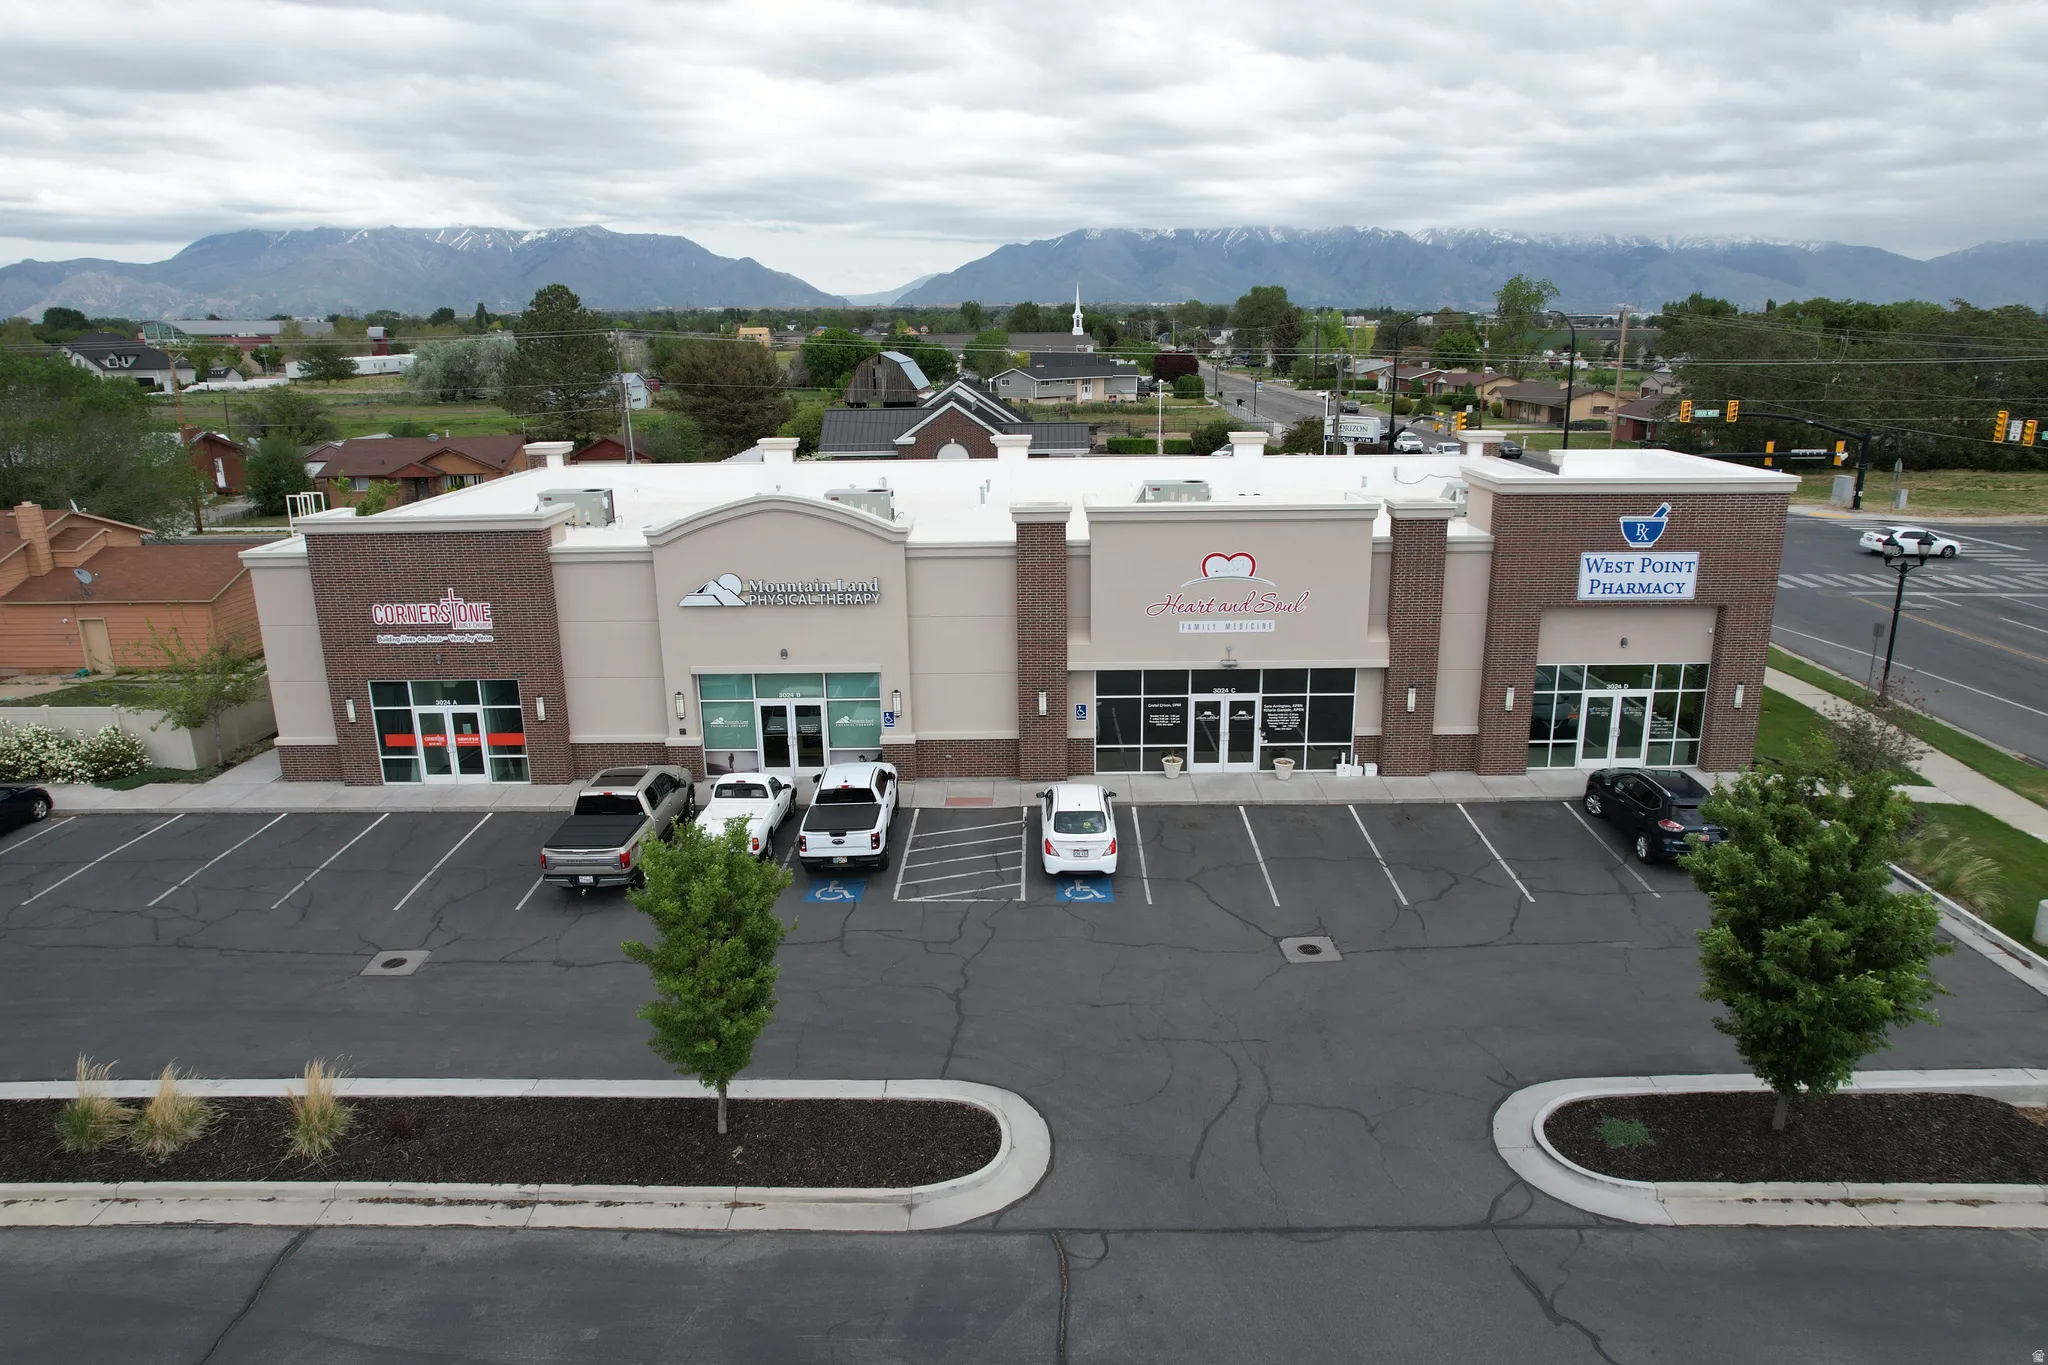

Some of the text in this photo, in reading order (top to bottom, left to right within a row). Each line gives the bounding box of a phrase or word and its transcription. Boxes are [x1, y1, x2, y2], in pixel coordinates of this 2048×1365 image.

[748, 577, 880, 593] Mountain Land
[749, 592, 881, 606] PHYSICAL THERAPY
[1145, 590, 1310, 617] Heart and Soul
[373, 589, 492, 629] CORNERSTONE
[1181, 622, 1273, 631] FAMILY MEDICINE
[378, 635, 400, 644] Building
[466, 635, 475, 643] by
